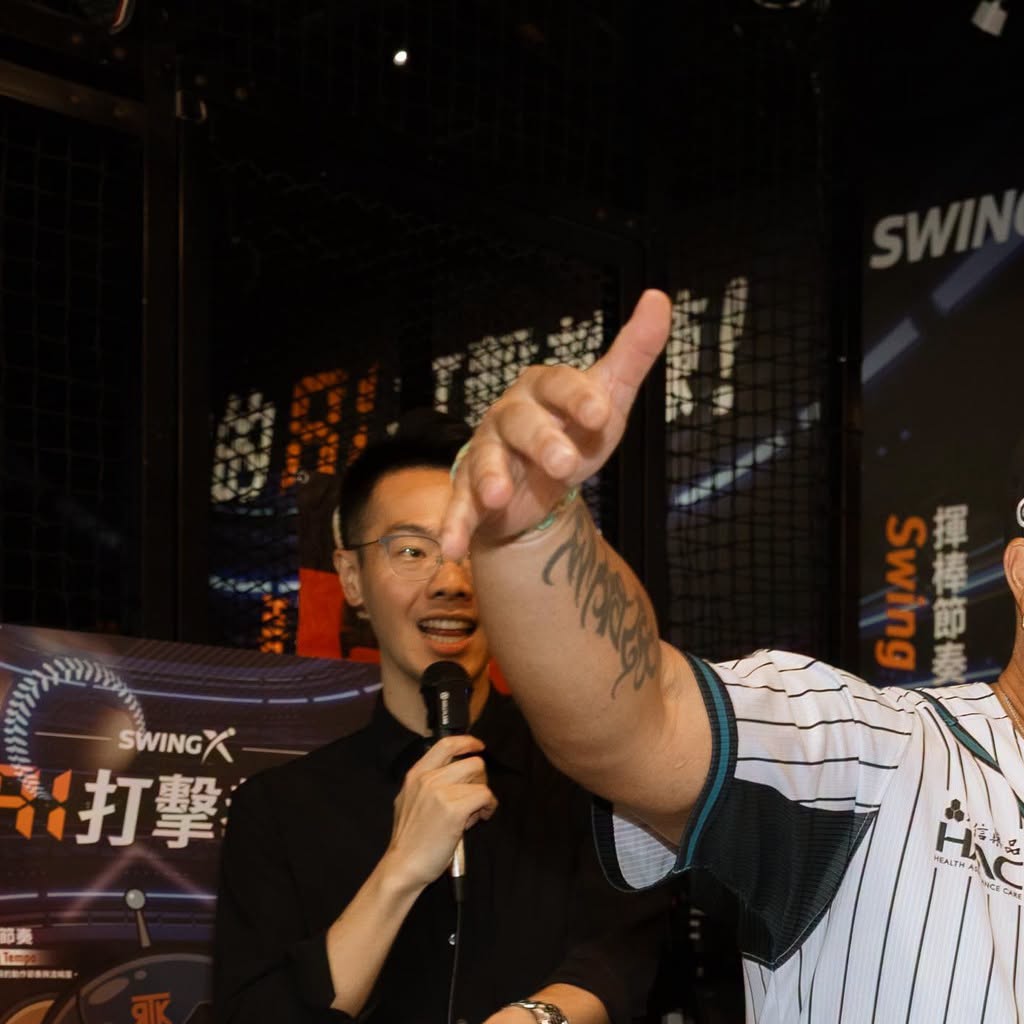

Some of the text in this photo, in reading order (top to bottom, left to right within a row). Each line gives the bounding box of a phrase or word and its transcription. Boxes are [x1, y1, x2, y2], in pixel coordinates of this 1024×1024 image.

[875, 514, 928, 671] Swing
[932, 504, 969, 685] 揮棒節奏
[934, 855, 965, 869] HEALTH
[1002, 887, 1023, 900] CARE
